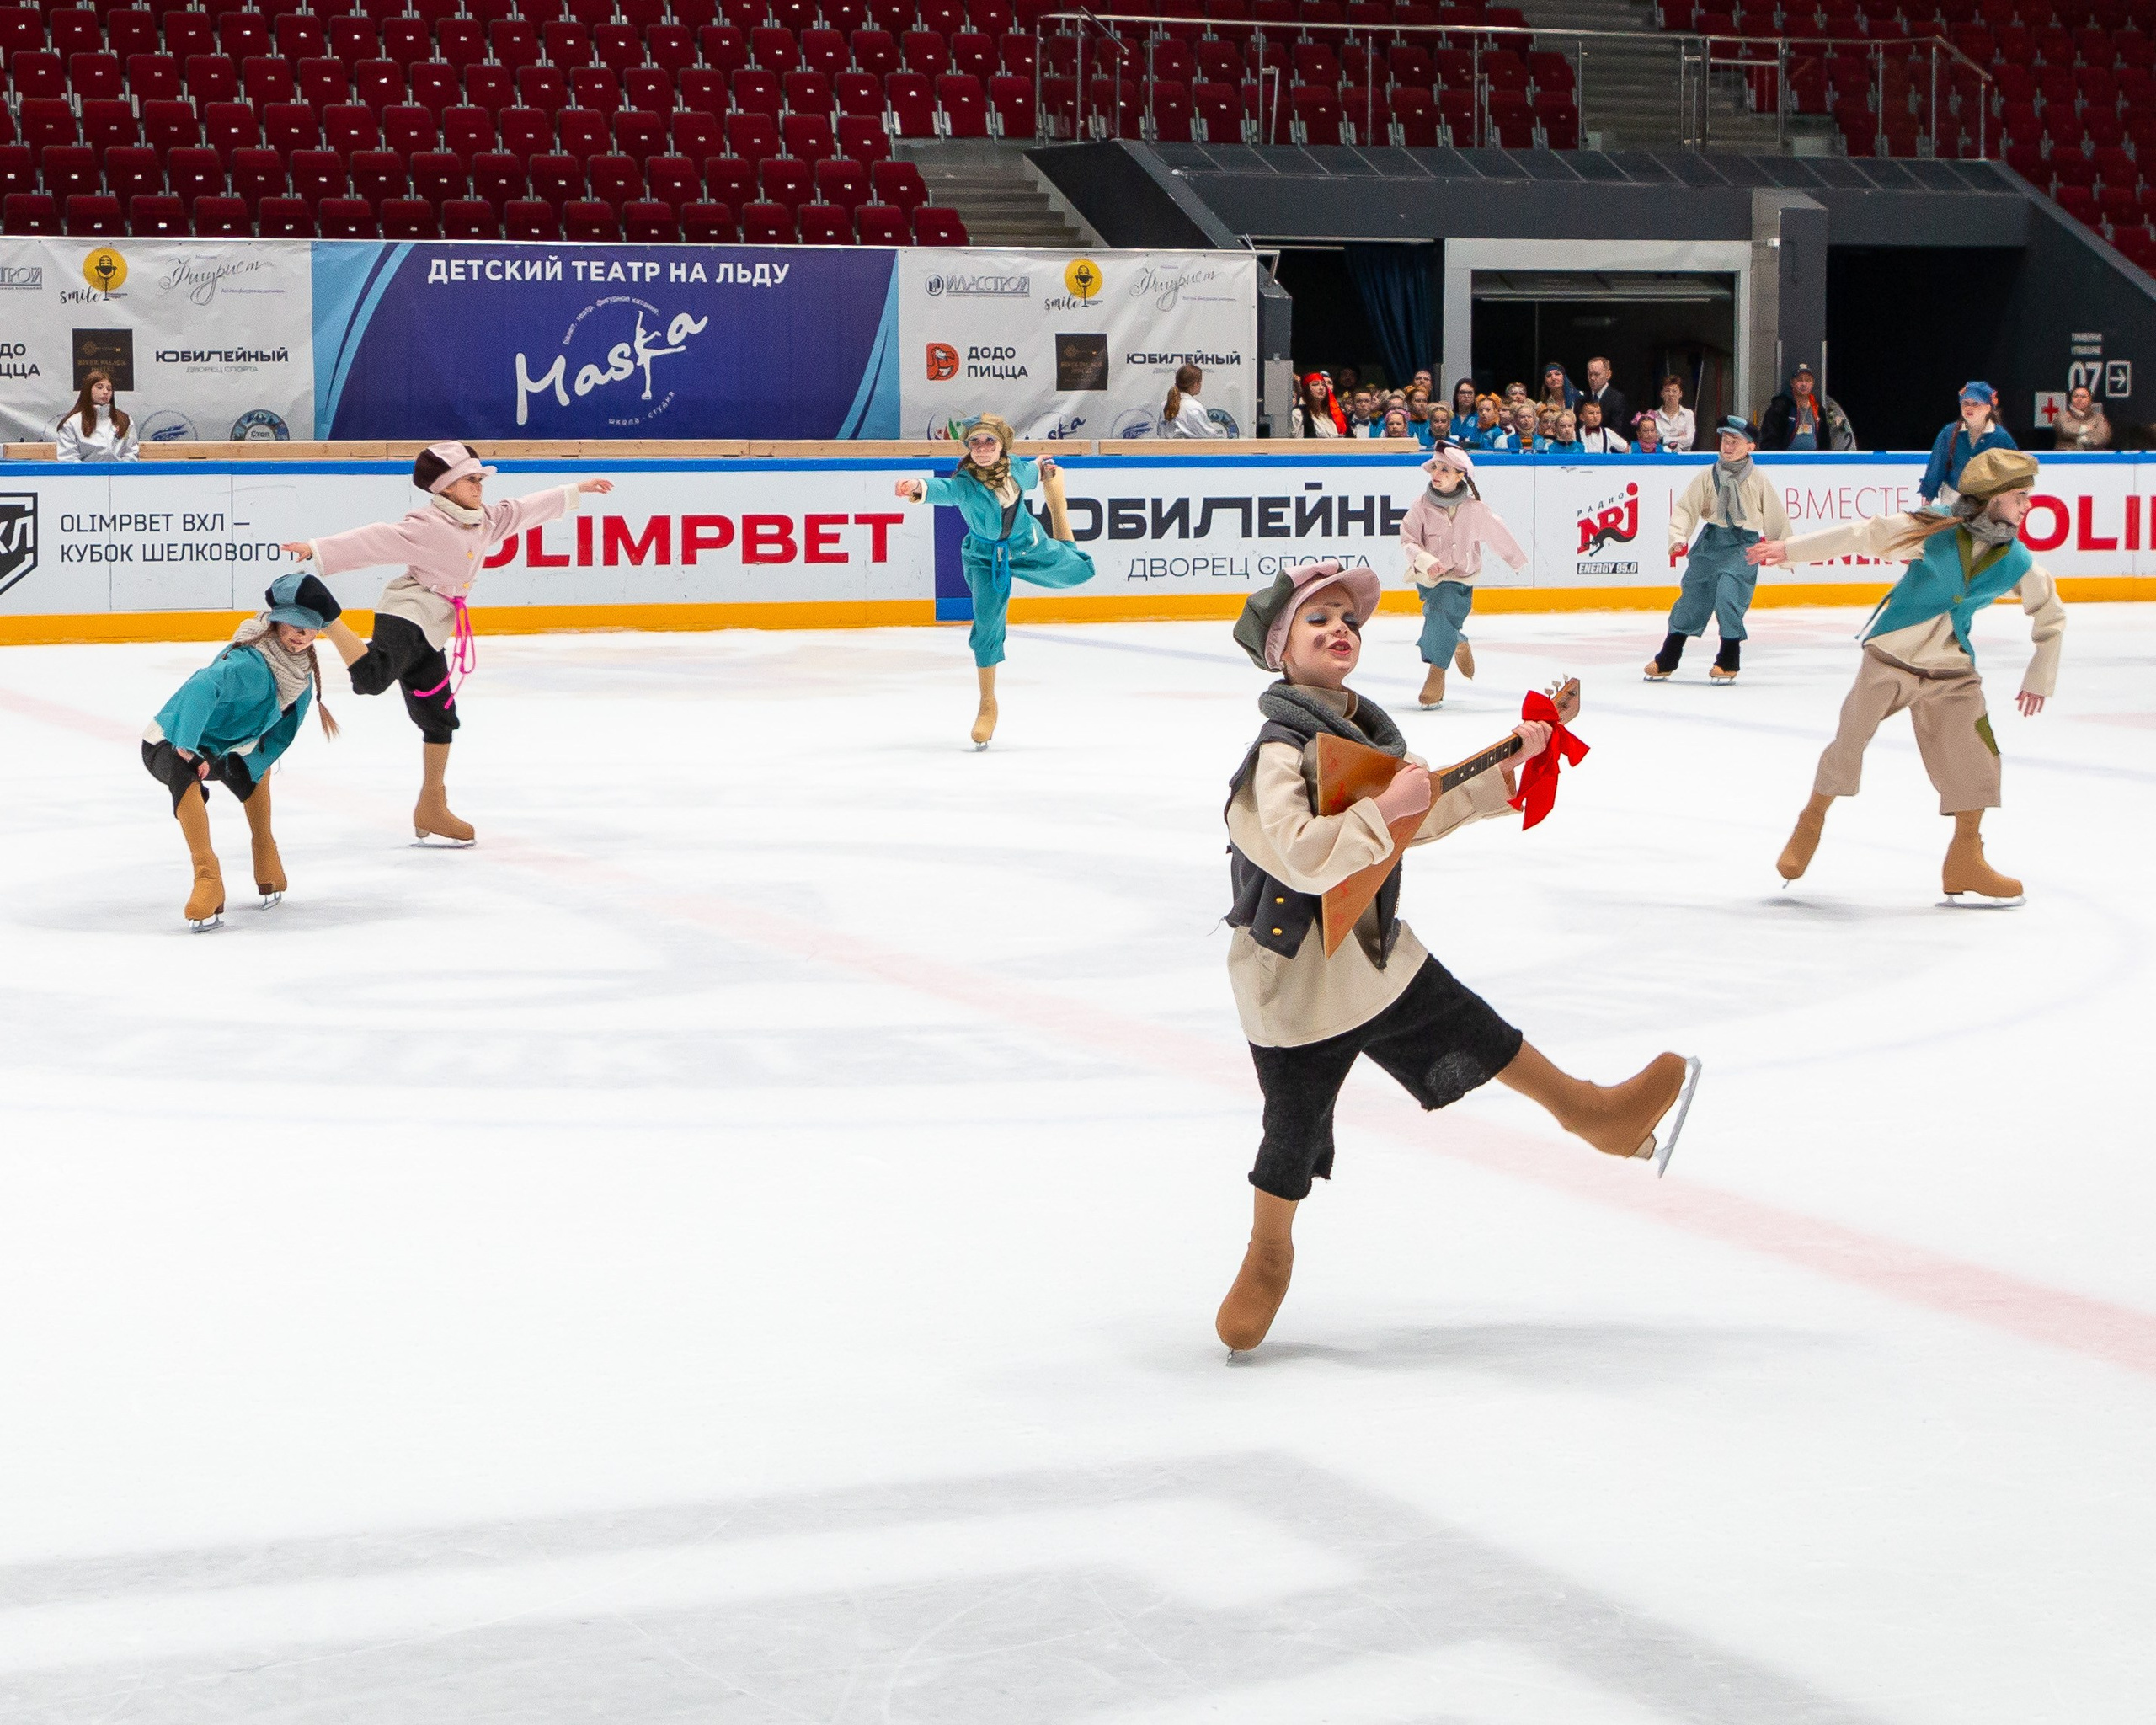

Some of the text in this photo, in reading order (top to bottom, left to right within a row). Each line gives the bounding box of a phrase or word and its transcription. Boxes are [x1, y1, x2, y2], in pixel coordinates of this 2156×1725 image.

[428, 256, 790, 287] ДЕТСКИЙ ТЕАТР НА ЛЬДУ
[155, 346, 289, 363] ЮБИЛЕЙНЫЙ
[967, 346, 1016, 361] ДОДО
[1126, 350, 1241, 366] ЮБИЛЕЙНЫЙ
[515, 312, 708, 426] Maska
[967, 365, 1029, 380] ПИЦЦА
[1577, 492, 1625, 517] РАДИО
[1785, 487, 1909, 520] ВМЕСТЕ
[61, 514, 173, 532] OLIMPBET
[183, 514, 225, 531] ВХЛ
[2017, 495, 2156, 552] OLI
[61, 544, 133, 563] КУБОК
[142, 543, 280, 562] ШЕЛКОВОГО
[1128, 558, 1250, 581] ДВОРЕЦ
[1578, 562, 1637, 574] ENERGY 95.0
